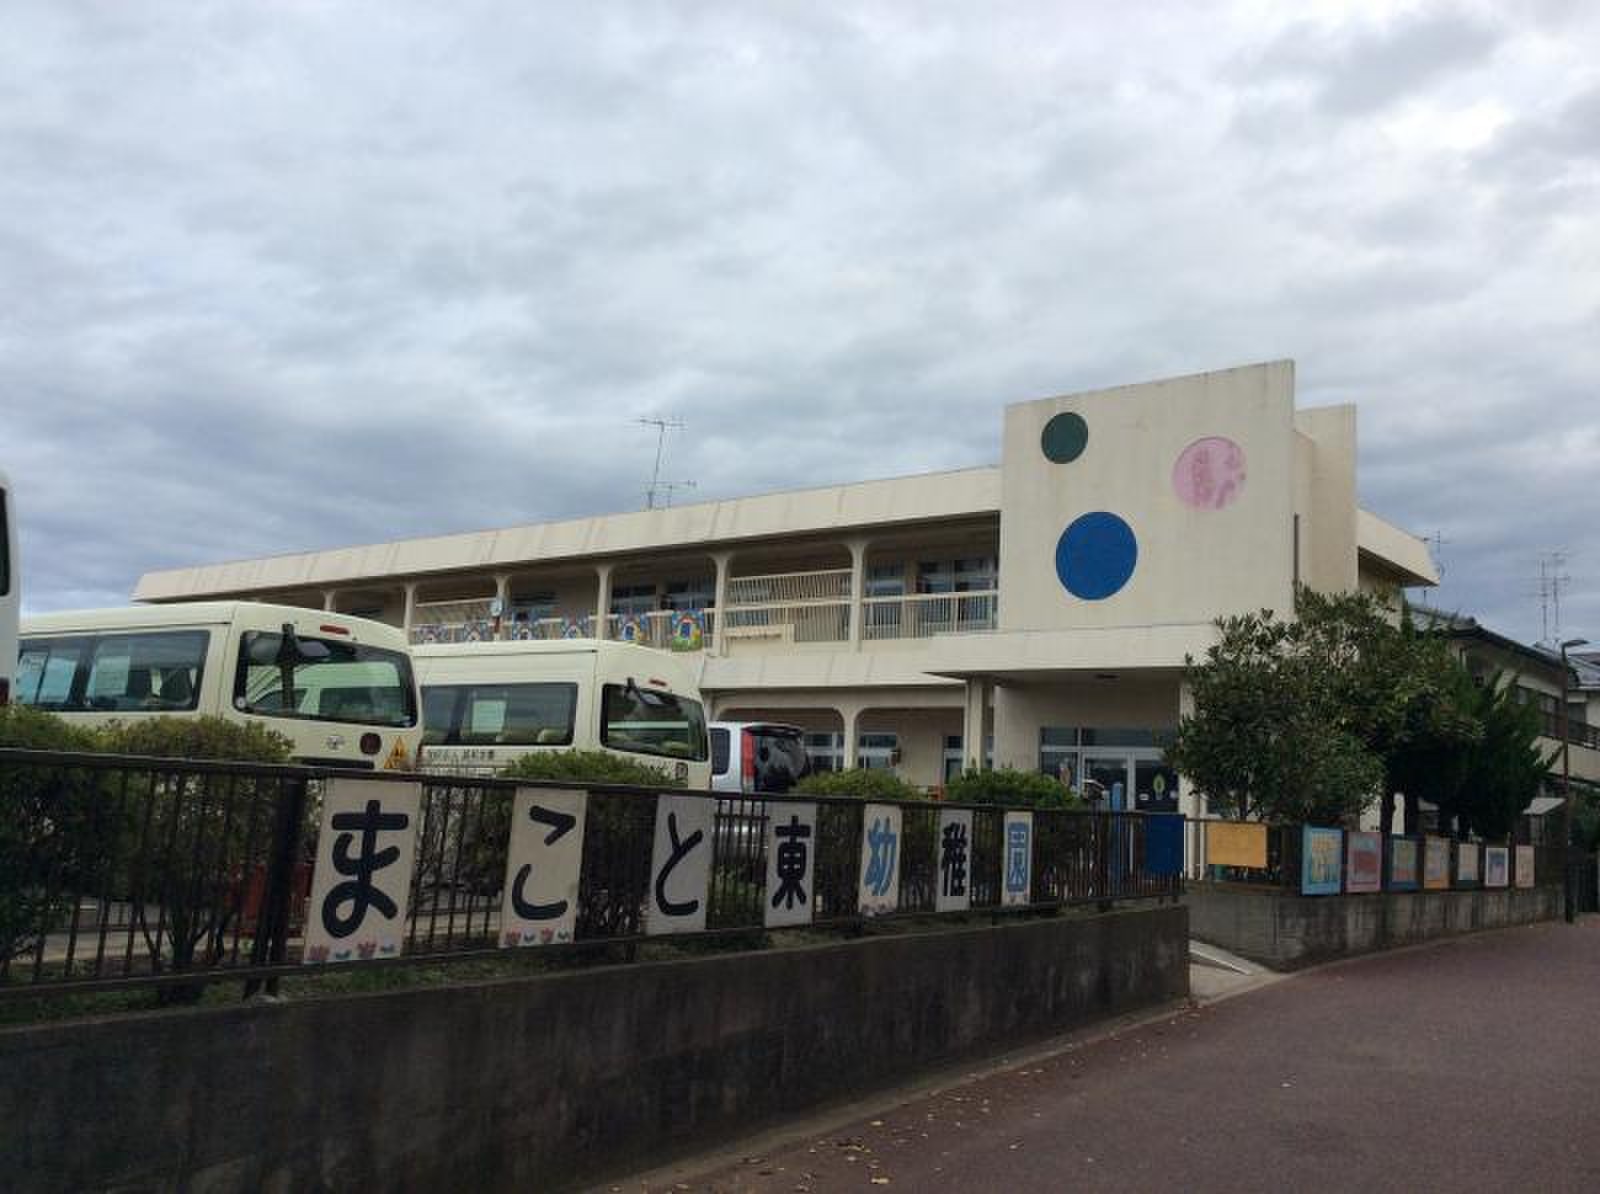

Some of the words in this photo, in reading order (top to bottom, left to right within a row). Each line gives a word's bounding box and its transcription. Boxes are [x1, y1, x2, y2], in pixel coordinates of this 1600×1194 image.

[321, 798, 409, 939] ま
[512, 805, 577, 920] こ
[654, 811, 703, 917] と
[772, 815, 812, 911] 東
[864, 815, 897, 897] 幼
